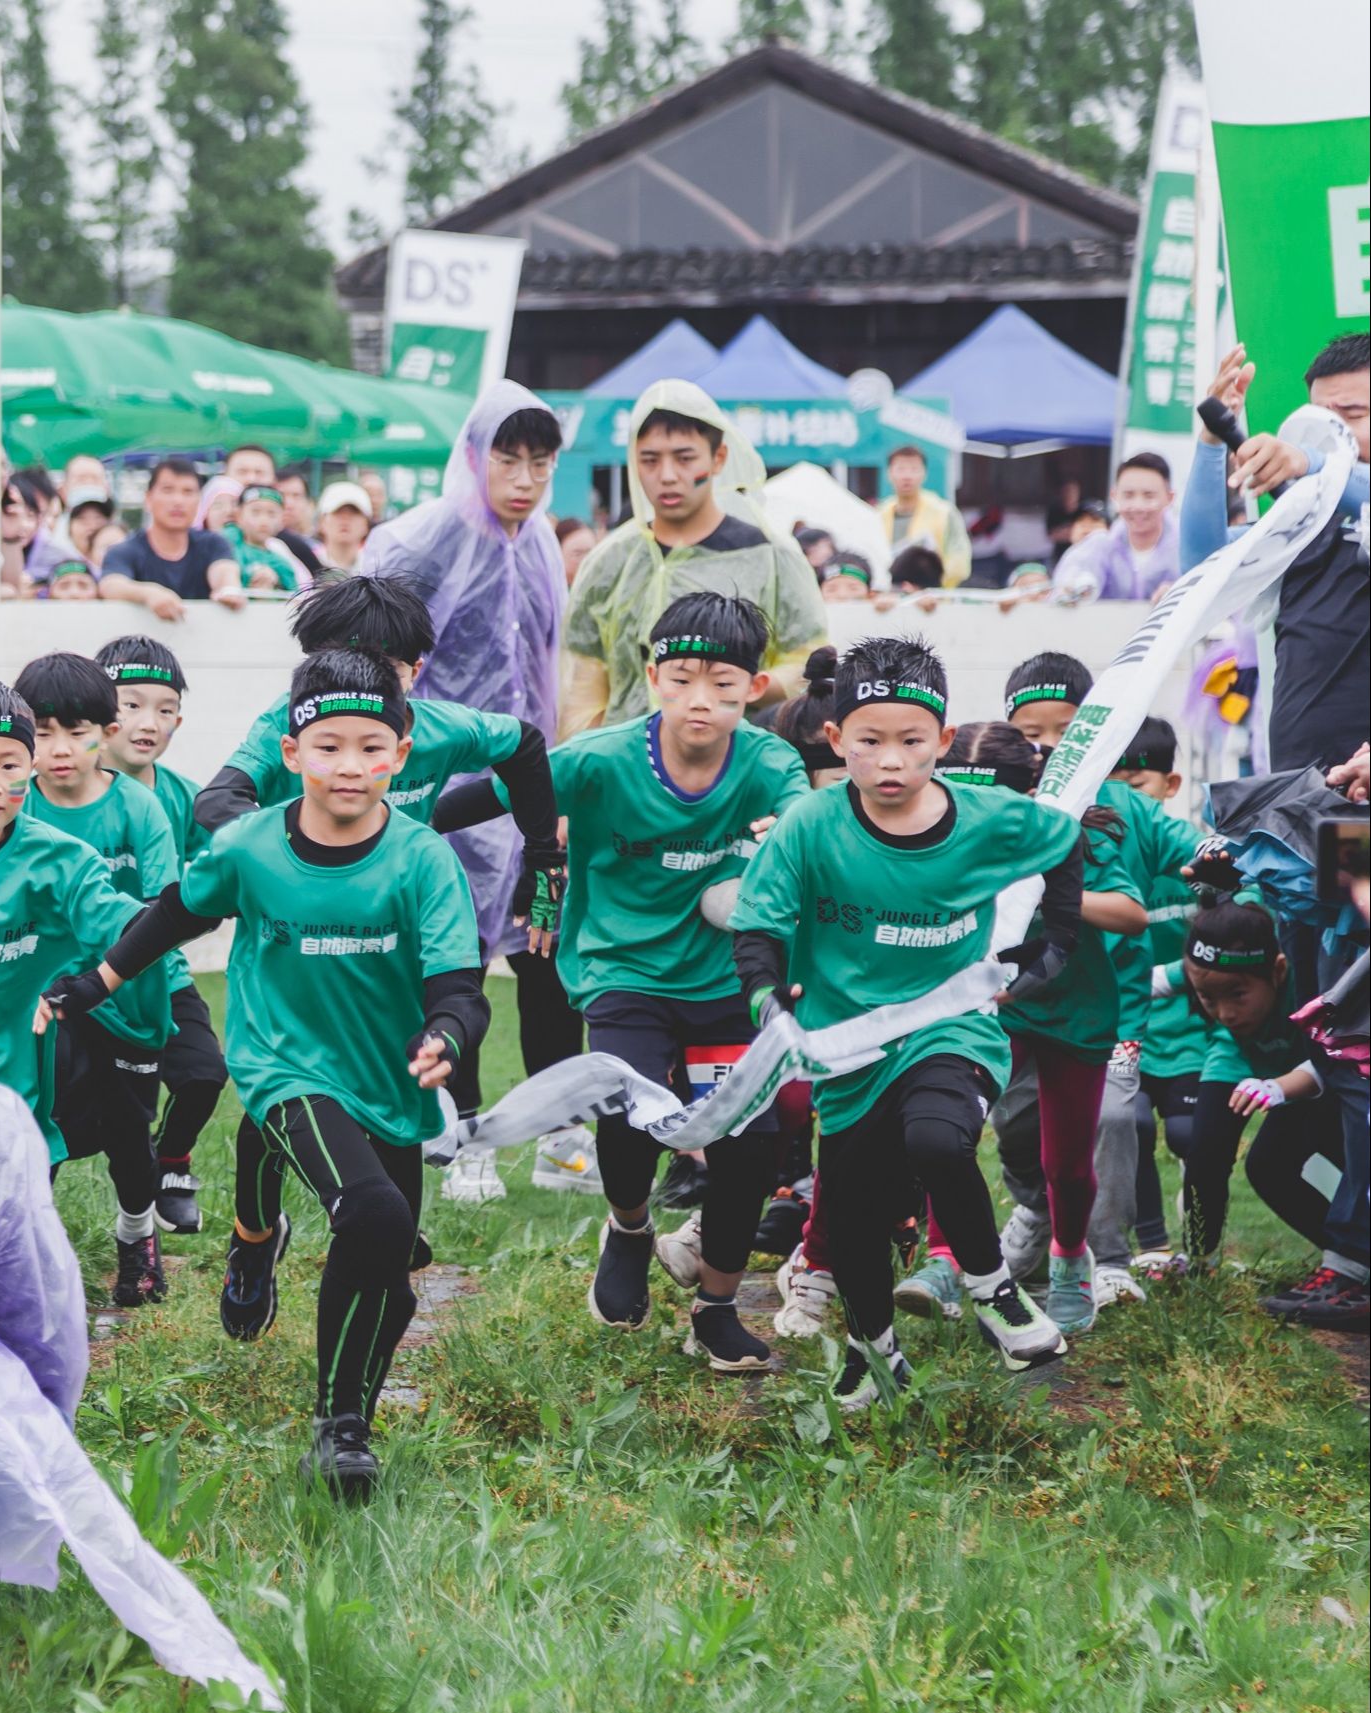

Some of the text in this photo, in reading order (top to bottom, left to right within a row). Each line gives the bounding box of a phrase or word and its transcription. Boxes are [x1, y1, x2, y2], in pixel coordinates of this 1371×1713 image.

[857, 680, 890, 700] DS
[294, 692, 384, 726] DS JUNGLE RACE
[816, 896, 864, 934] DS
[875, 910, 942, 925] JUNGLE
[4, 921, 37, 942] RACE
[300, 924, 357, 935] JUNGLE
[362, 922, 398, 936] RACE
[1193, 940, 1215, 962] DS
[162, 1172, 191, 1190] NIKE
